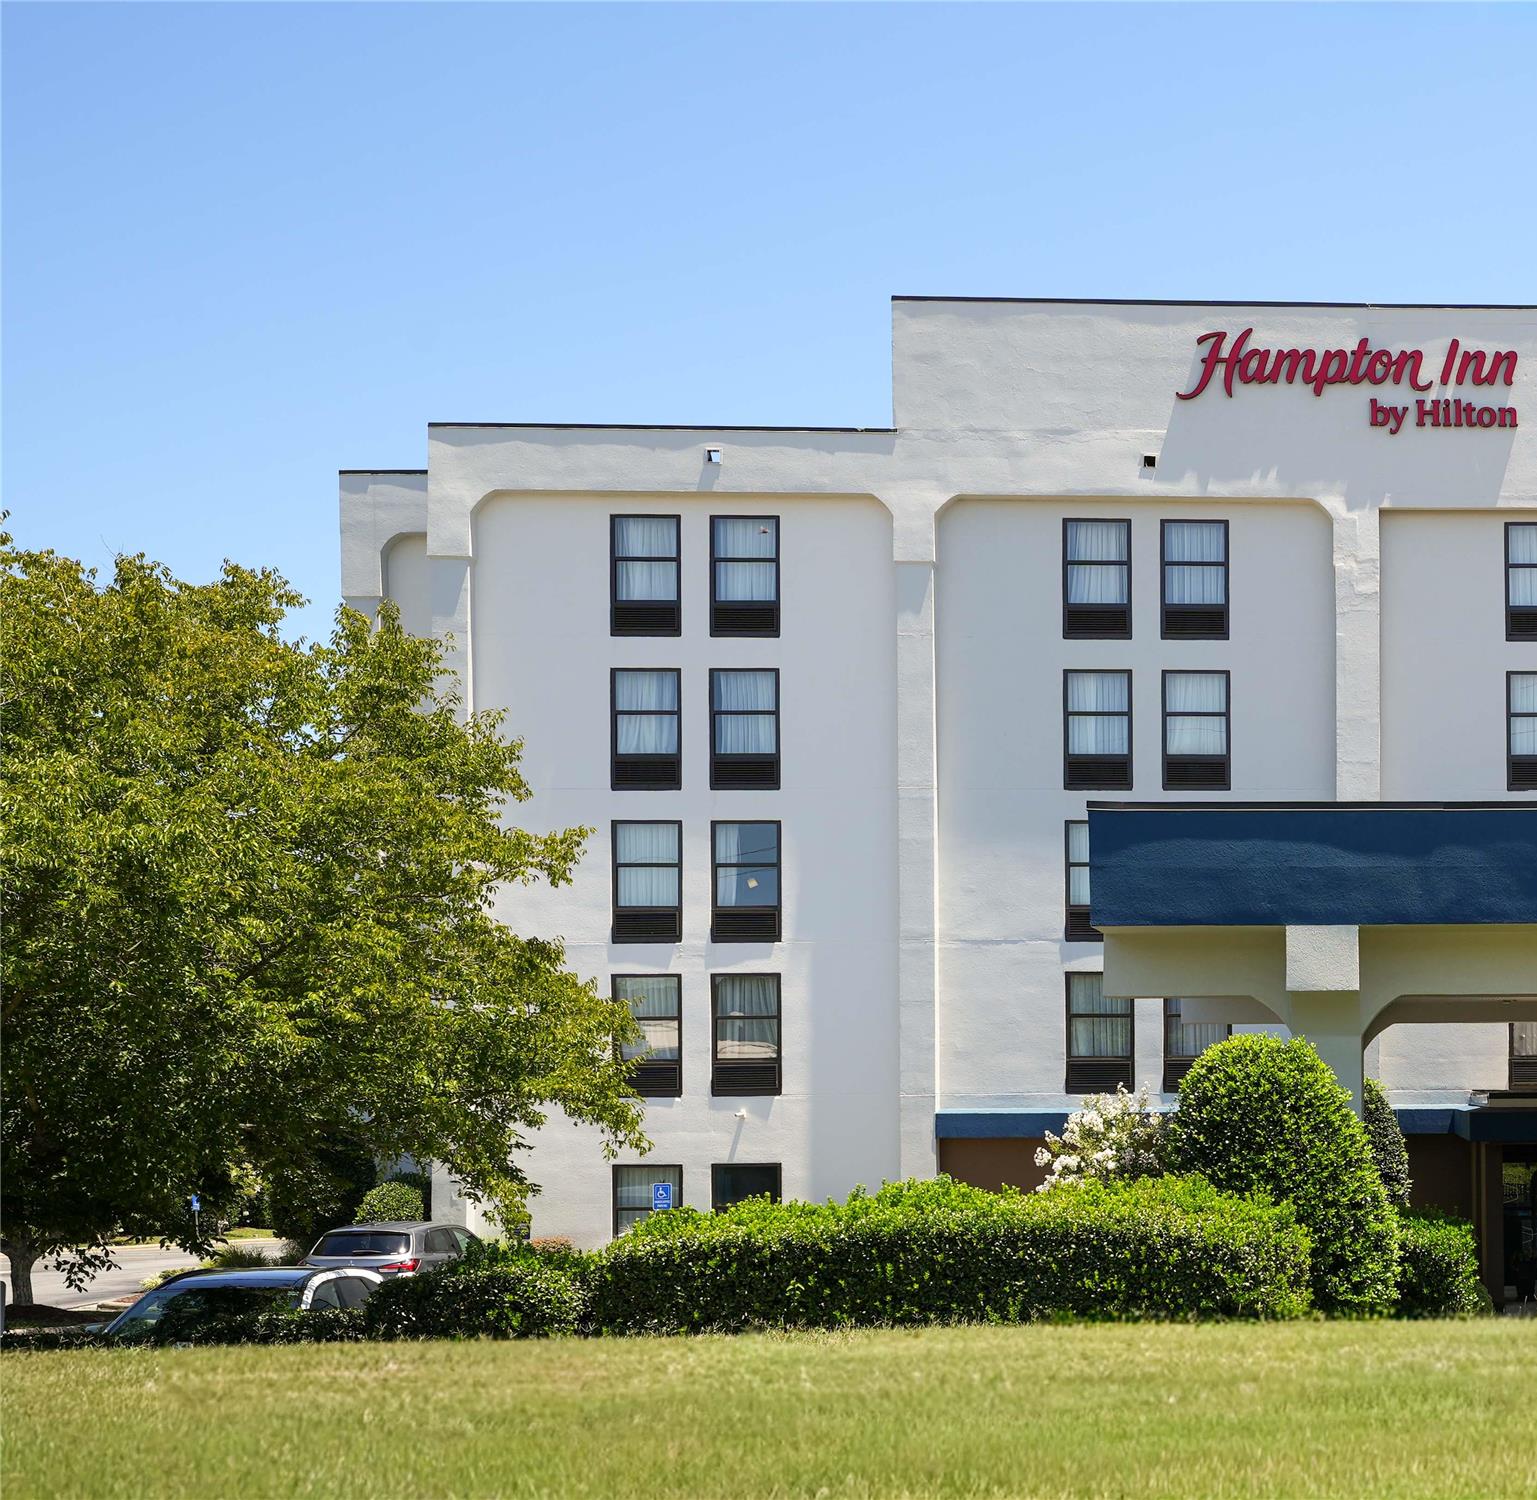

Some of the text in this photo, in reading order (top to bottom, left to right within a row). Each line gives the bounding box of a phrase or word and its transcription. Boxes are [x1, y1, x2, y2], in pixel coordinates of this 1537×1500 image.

[1175, 327, 1518, 400] Hampton Inn
[1369, 398, 1519, 435] by Hilton
